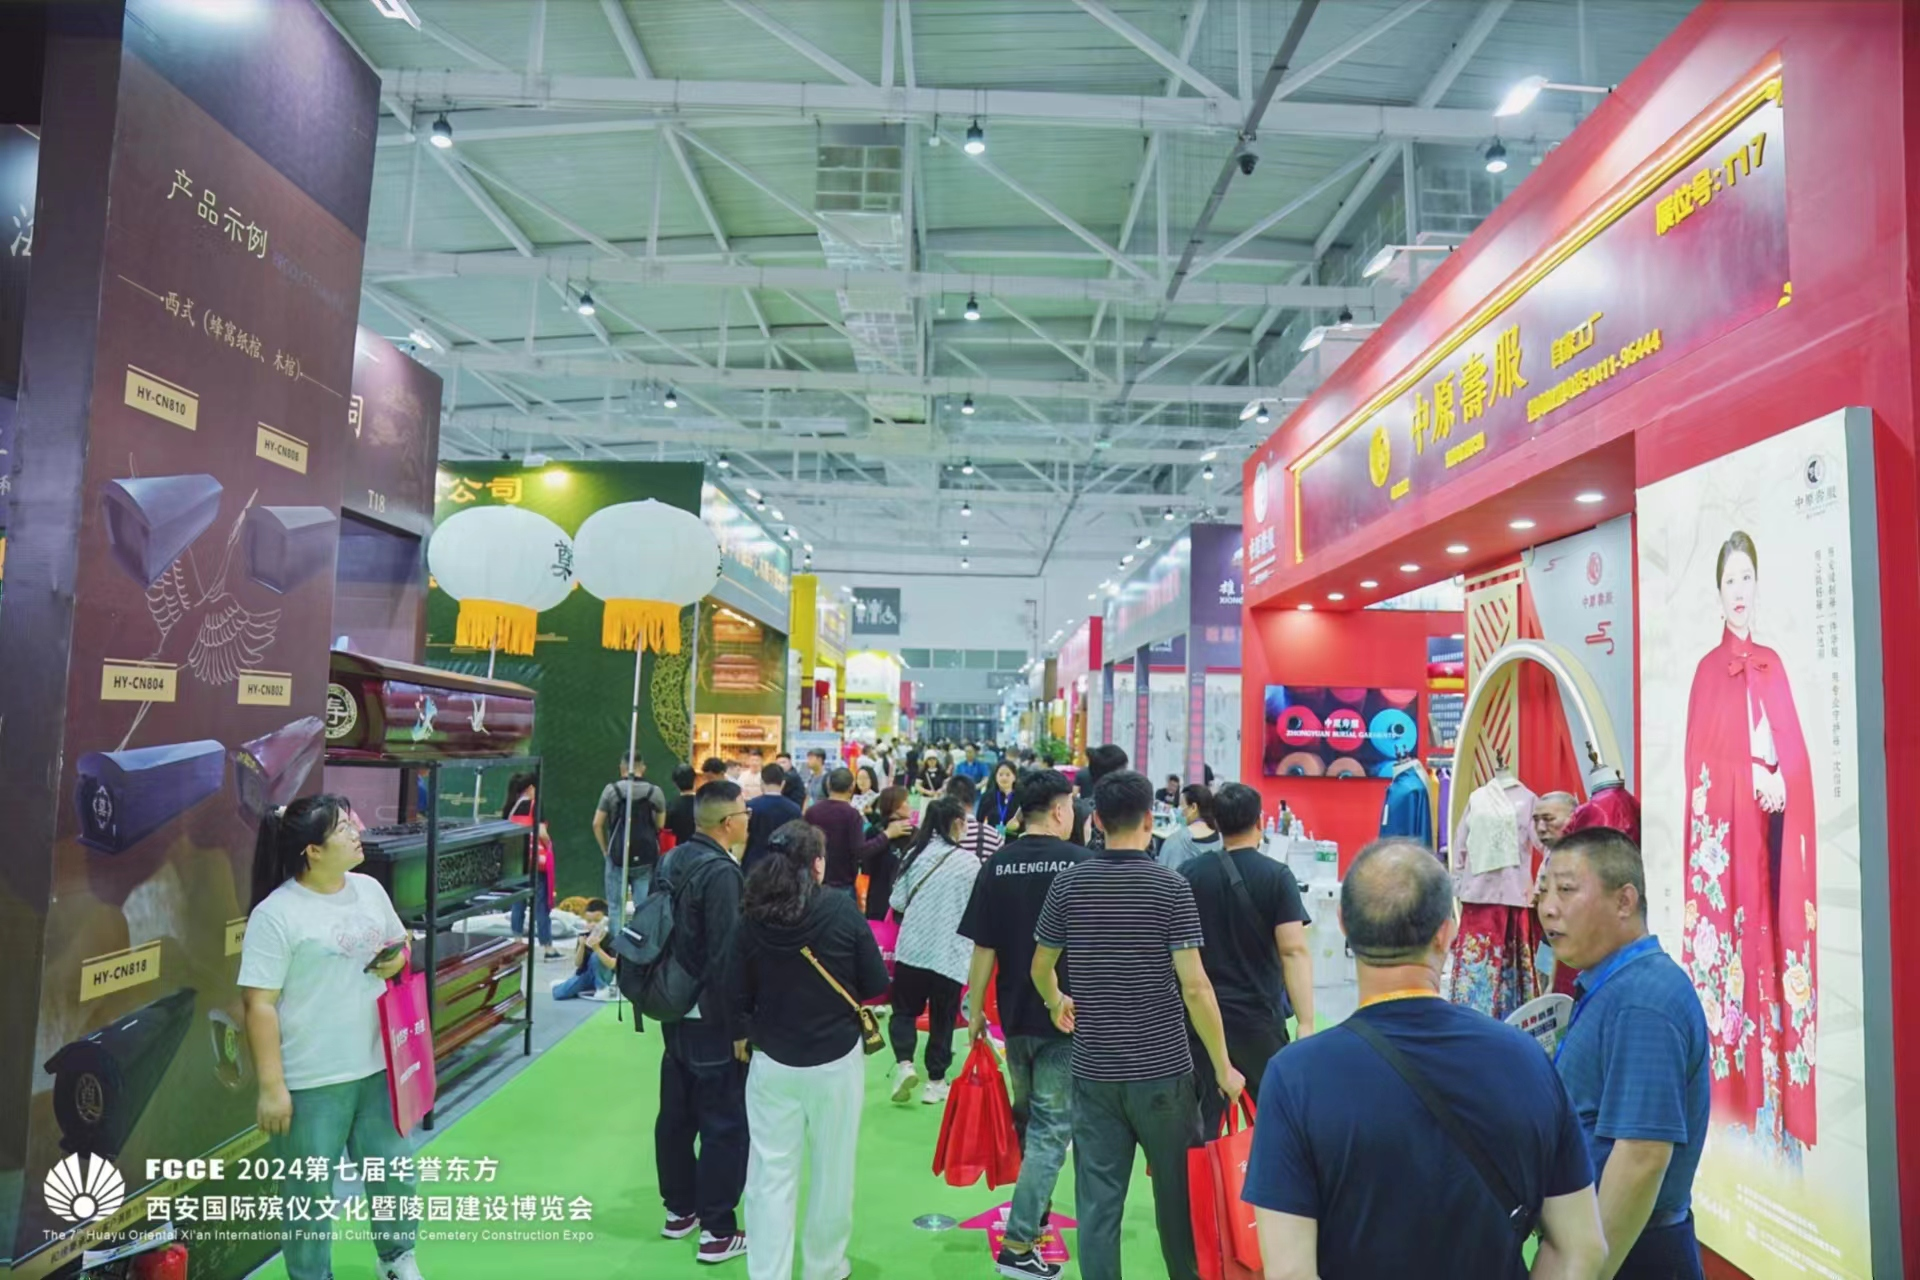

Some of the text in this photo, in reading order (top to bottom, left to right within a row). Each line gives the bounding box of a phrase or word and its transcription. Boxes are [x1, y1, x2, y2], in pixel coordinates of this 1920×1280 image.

[167, 169, 268, 259] 产品示例
[137, 385, 186, 416] HY-CN810
[367, 489, 386, 513] T18
[443, 476, 523, 504] 公司
[113, 675, 164, 691] HY-CN804
[247, 684, 284, 697] HY-CN802
[93, 959, 147, 986] HY-CN818
